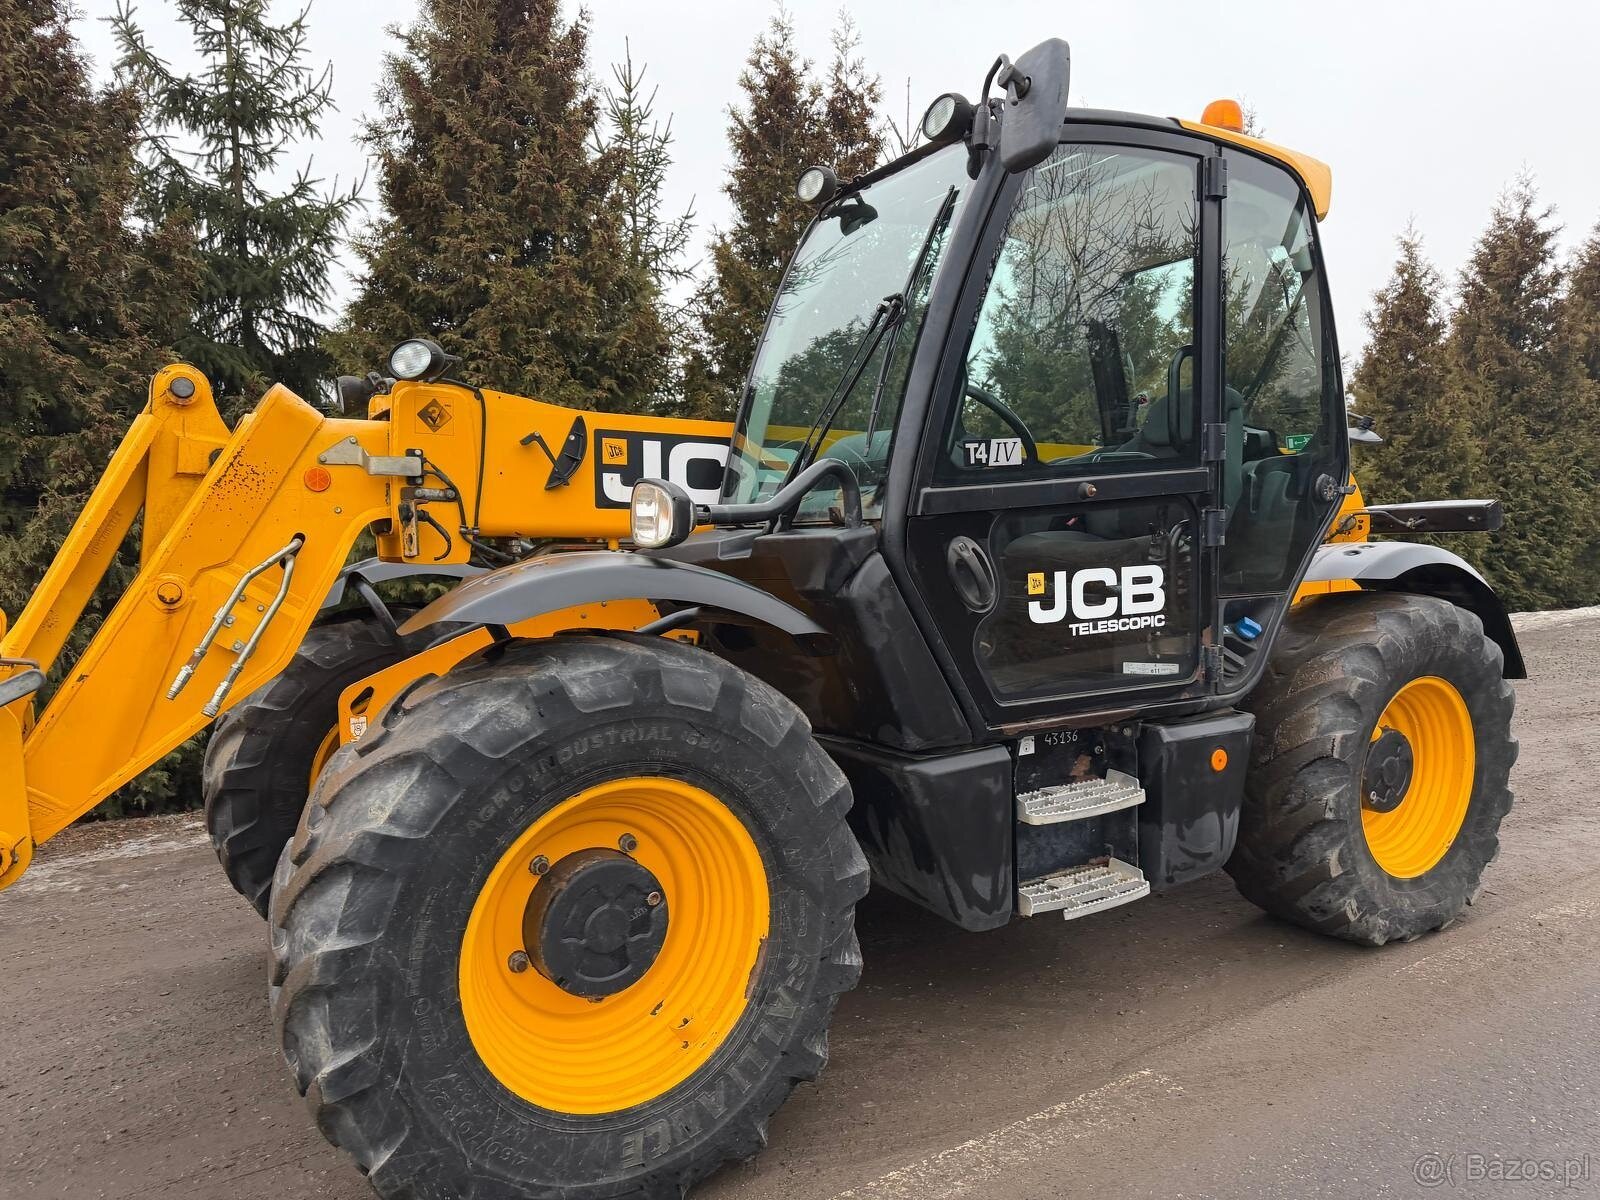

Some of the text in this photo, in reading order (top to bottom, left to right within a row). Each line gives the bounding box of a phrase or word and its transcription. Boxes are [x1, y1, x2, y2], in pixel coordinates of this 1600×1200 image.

[965, 441, 1018, 465] T4 IV
[1028, 564, 1166, 624] JCB
[1068, 614, 1166, 637] TELESCOPIC
[1044, 729, 1078, 746] 43136
[622, 984, 799, 1169] ALLIANCE
